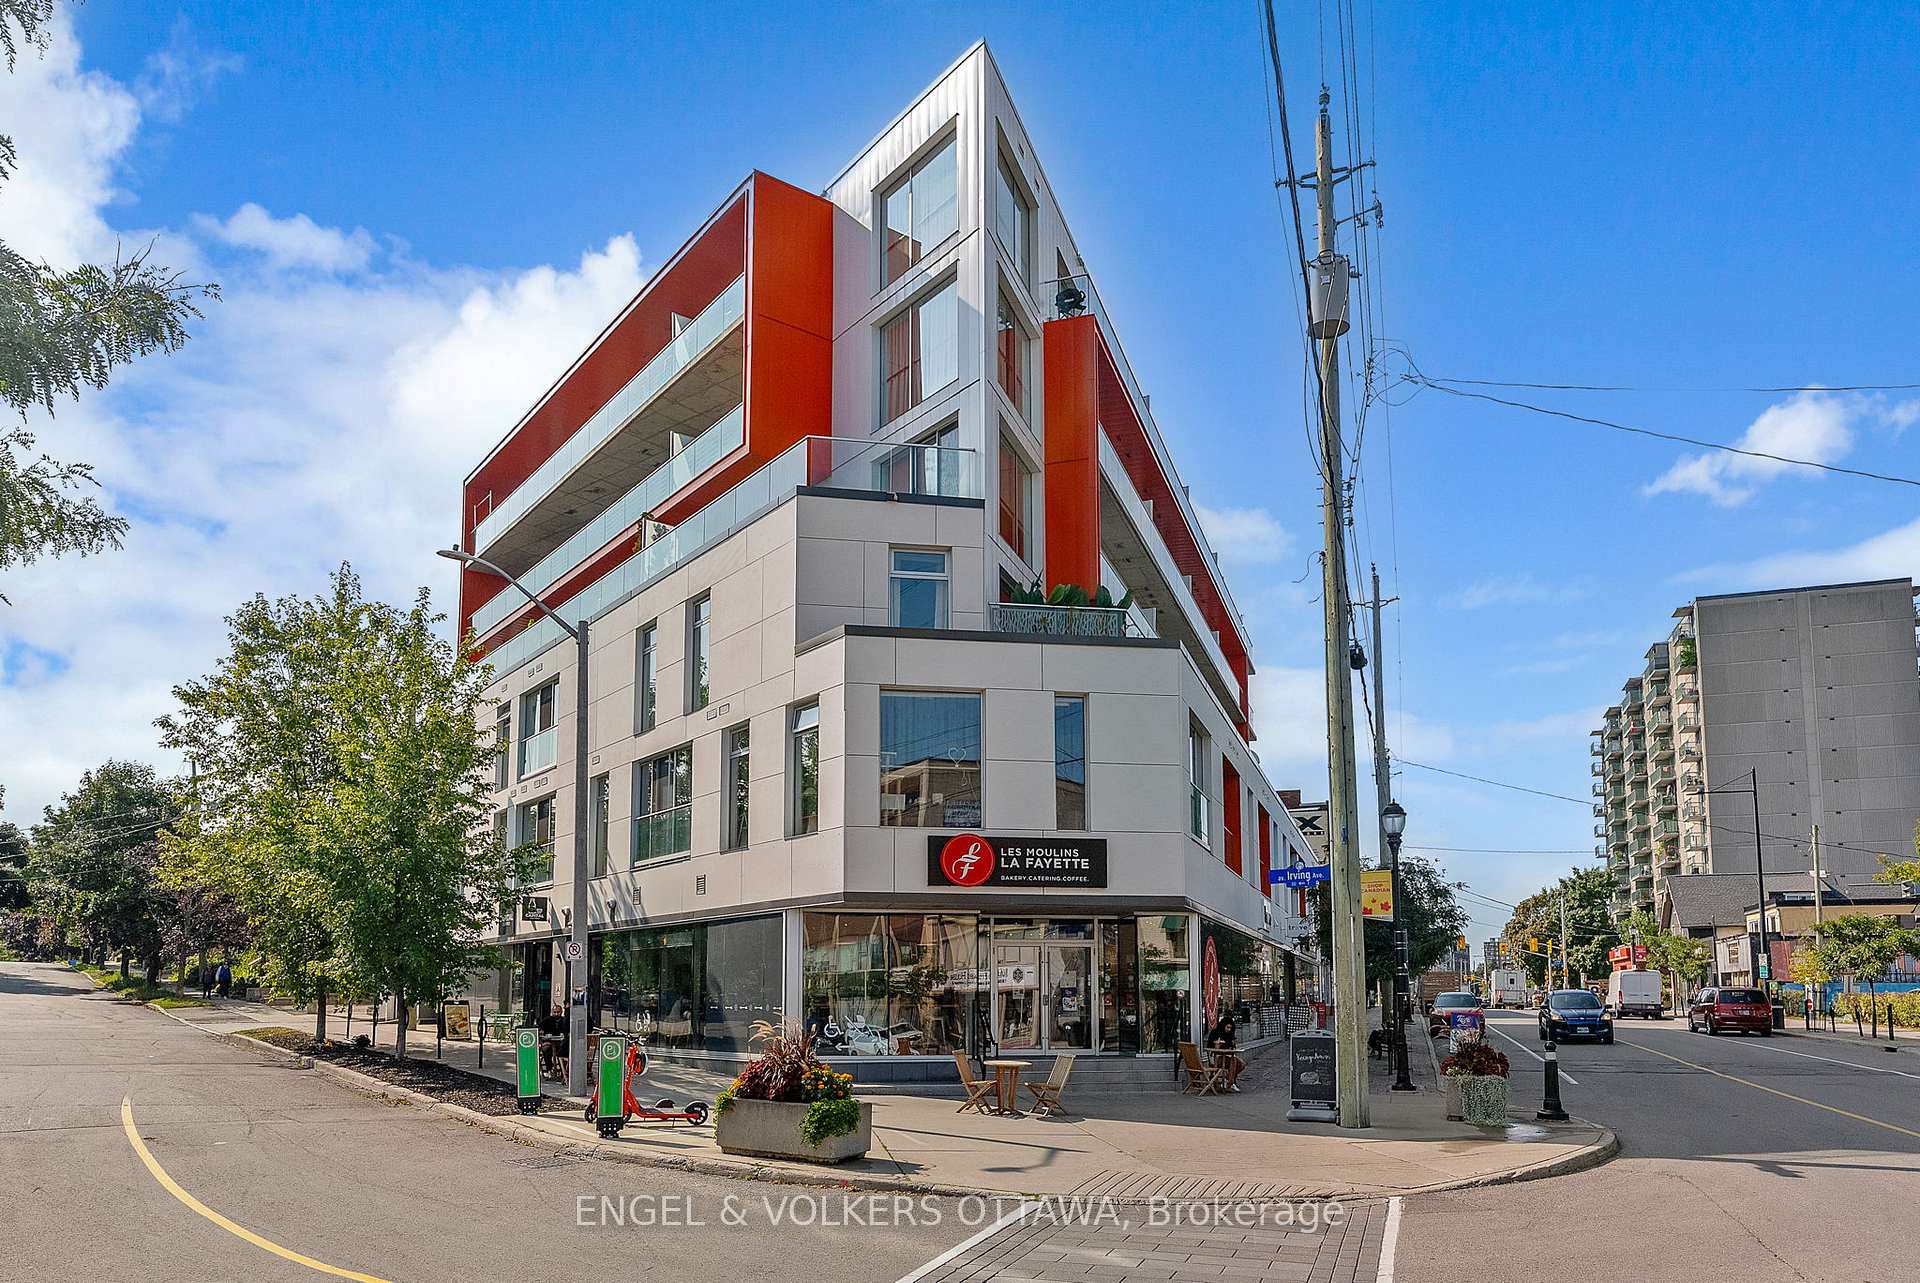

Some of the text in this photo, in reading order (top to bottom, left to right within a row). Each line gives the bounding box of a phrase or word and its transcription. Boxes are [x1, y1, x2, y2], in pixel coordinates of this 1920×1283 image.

[1001, 848, 1079, 857] LES MOULINS
[1000, 857, 1090, 869] LA FAYETTE
[1287, 871, 1311, 882] Irving
[1312, 872, 1325, 880] Ave.
